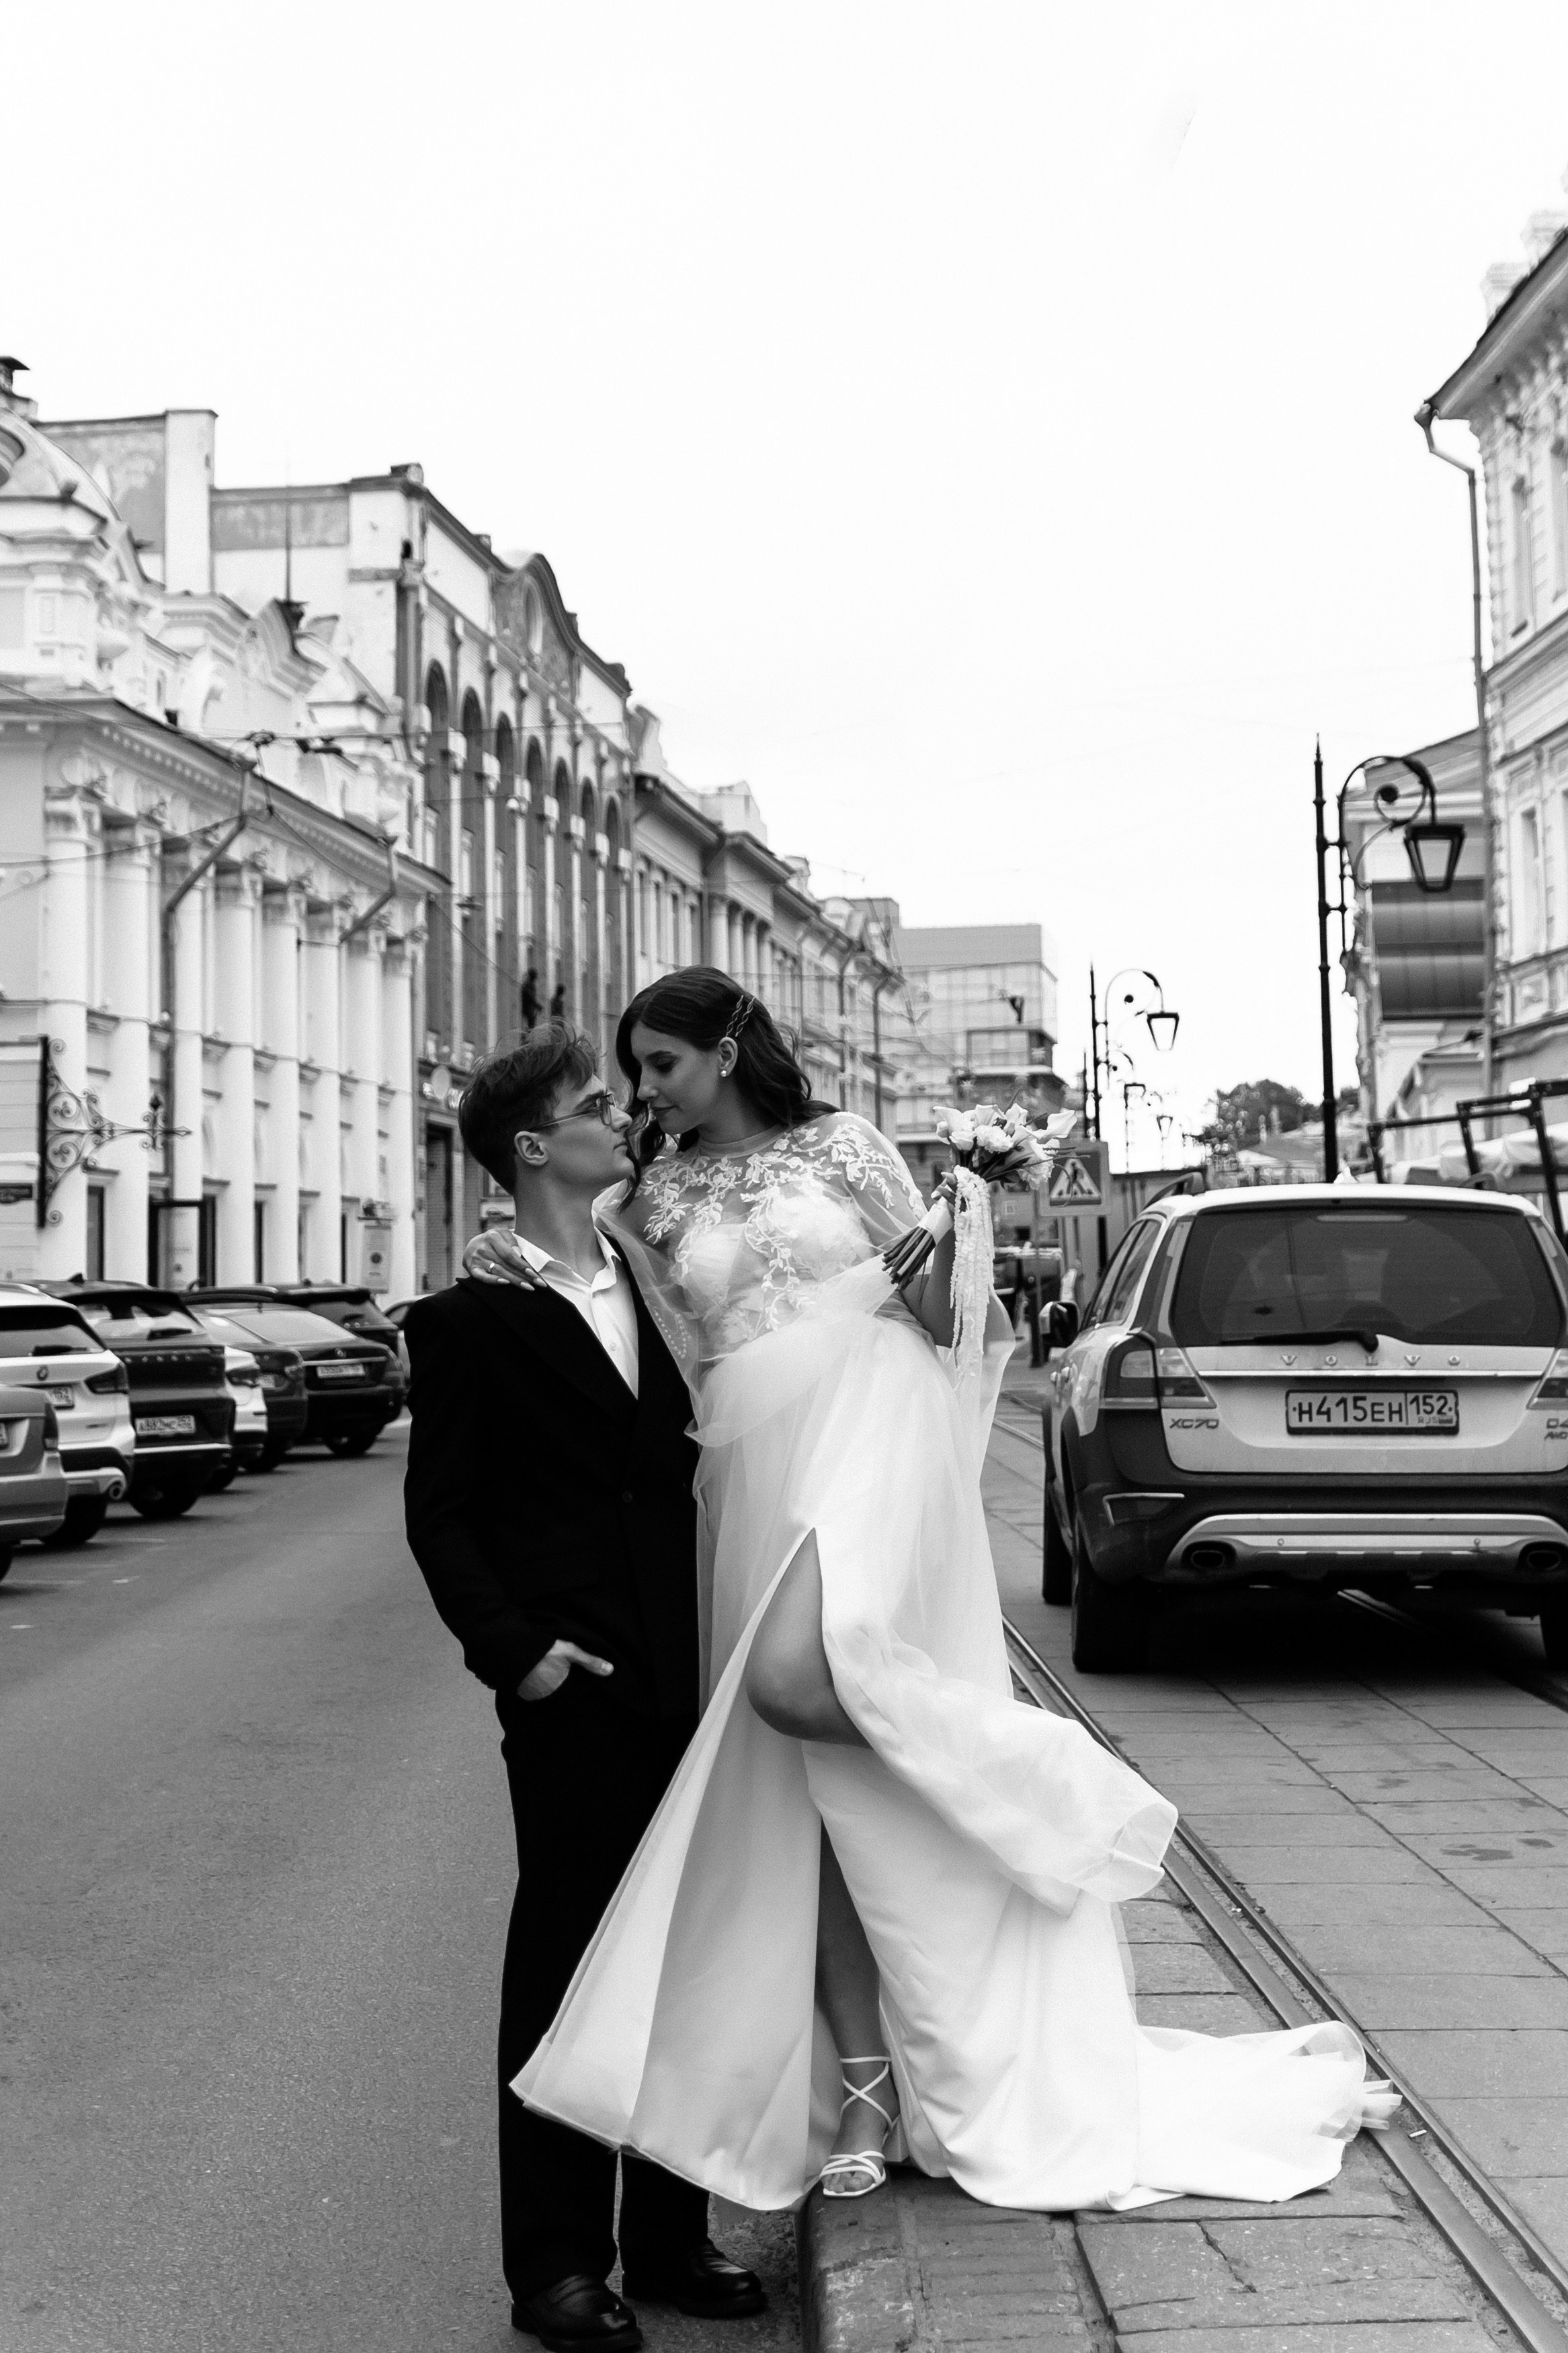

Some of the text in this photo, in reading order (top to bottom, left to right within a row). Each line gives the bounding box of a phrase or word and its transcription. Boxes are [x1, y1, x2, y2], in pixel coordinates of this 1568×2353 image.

[1280, 1354, 1460, 1367] VOLVO
[1409, 1394, 1448, 1415] 152
[1169, 1418, 1220, 1429] XC70
